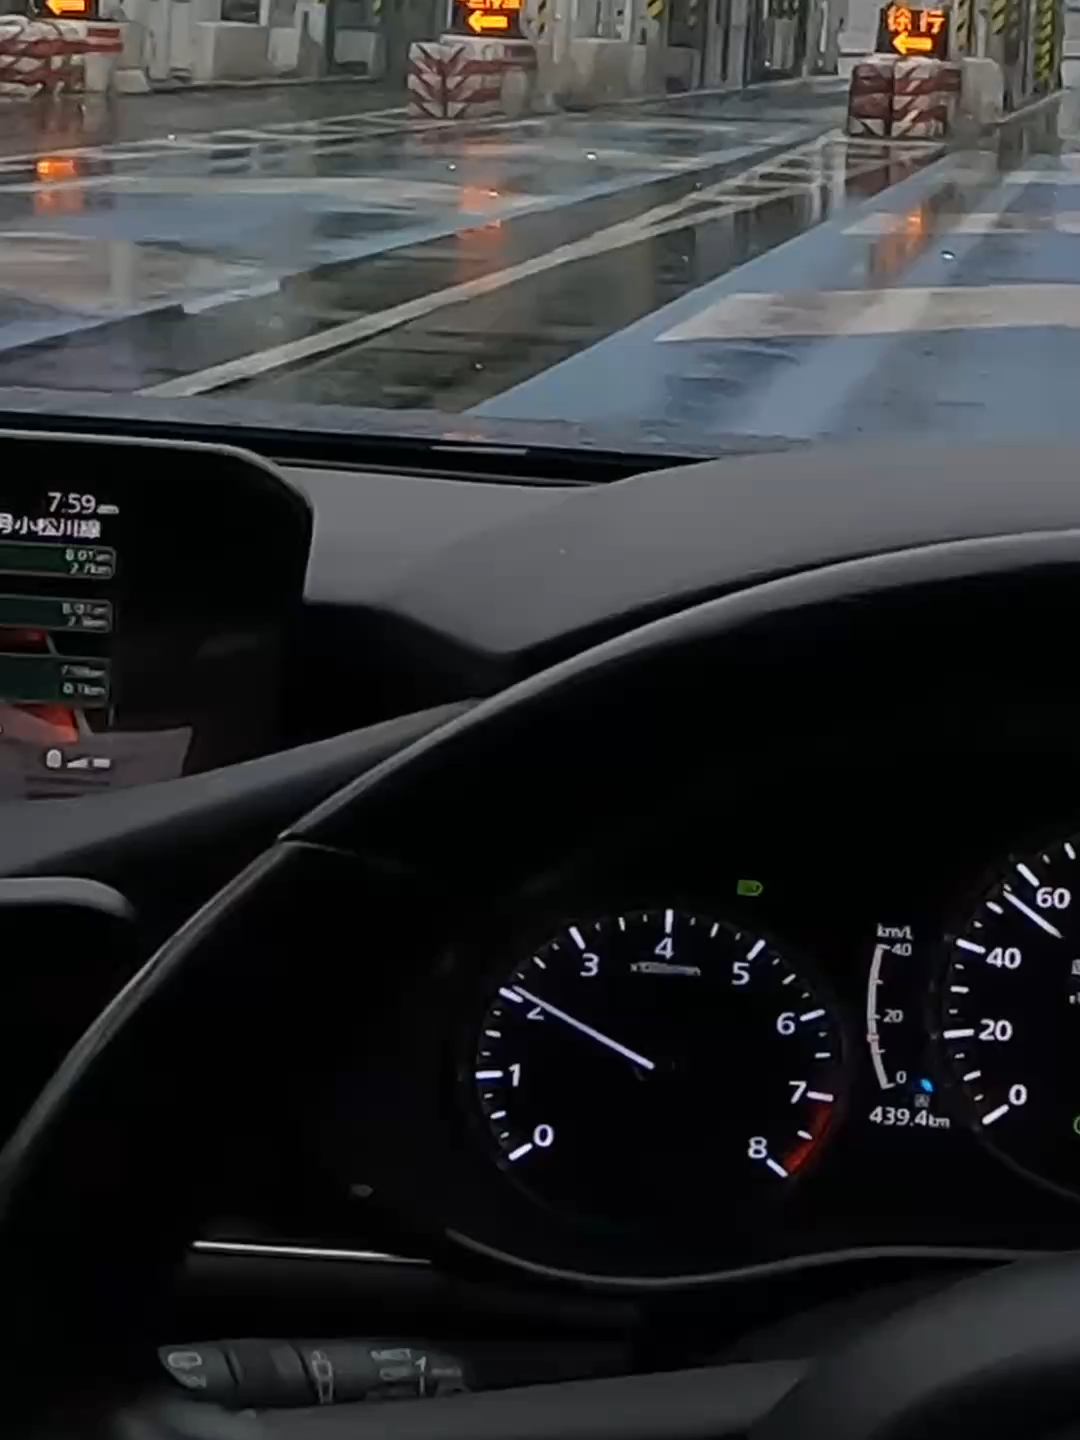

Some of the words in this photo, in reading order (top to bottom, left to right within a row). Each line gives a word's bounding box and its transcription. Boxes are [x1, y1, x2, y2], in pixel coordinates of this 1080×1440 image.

[48, 492, 96, 514] 7:59
[1035, 887, 1071, 909] 60
[654, 937, 675, 960] 4
[891, 943, 912, 957] 40
[985, 947, 1022, 970] 40
[580, 953, 599, 977] 3
[732, 961, 750, 985] 5
[776, 1012, 796, 1035] 6
[883, 1009, 904, 1023] 20
[978, 1019, 1013, 1041] 20
[509, 1063, 521, 1087] 1
[896, 1070, 907, 1084] 0
[789, 1081, 807, 1104] 7
[1007, 1084, 1027, 1106] 0
[532, 1124, 554, 1147] 0
[747, 1136, 768, 1159] 8
